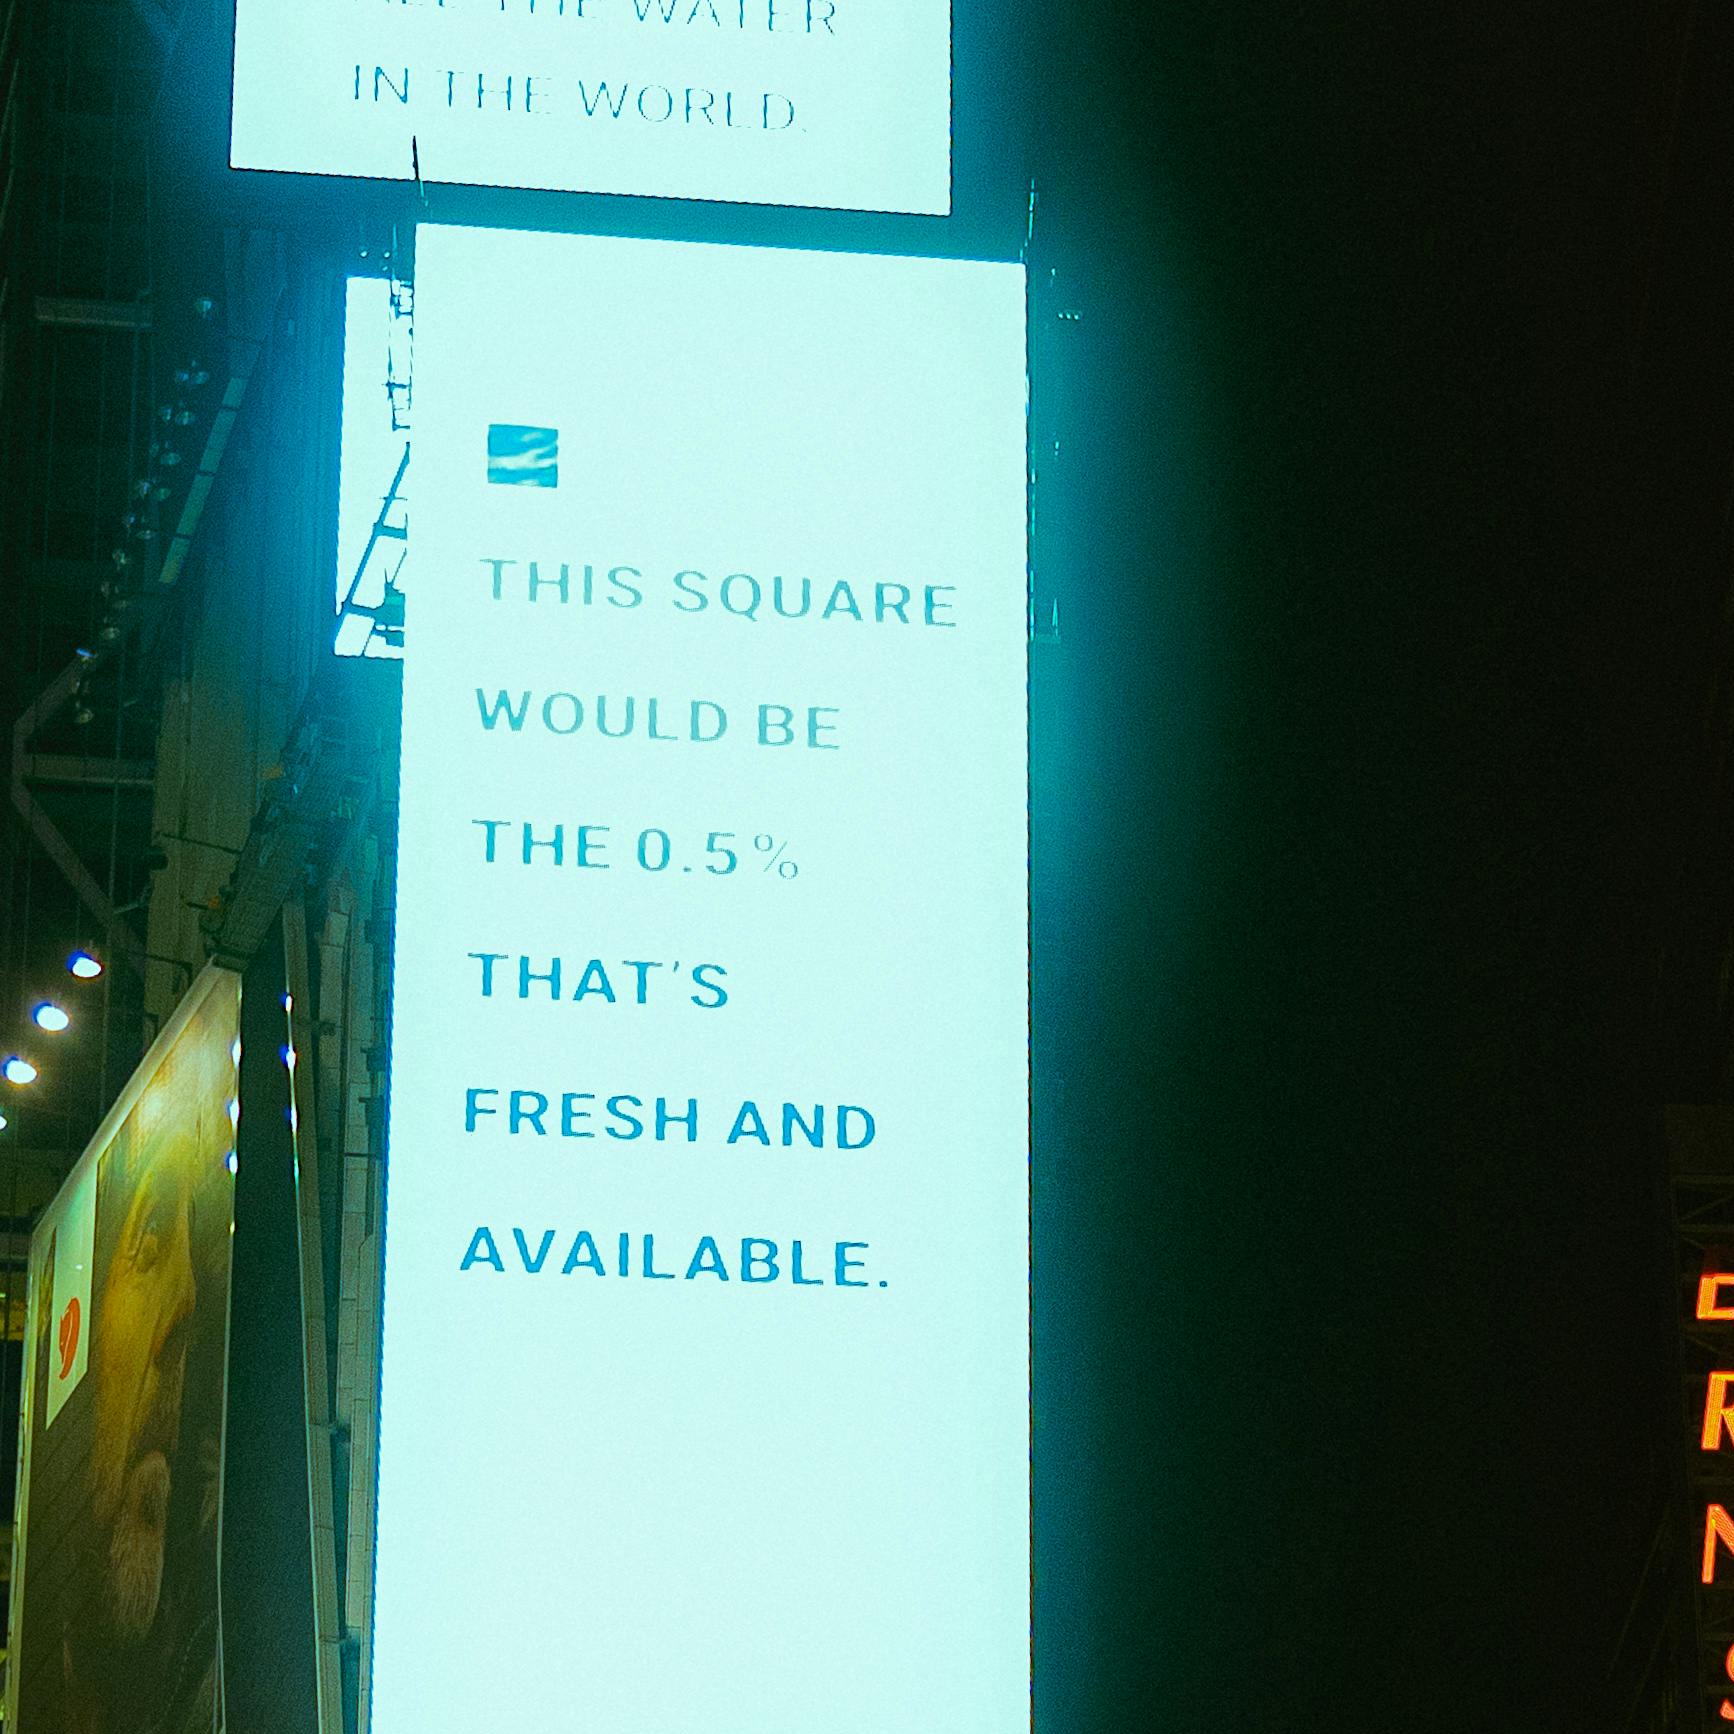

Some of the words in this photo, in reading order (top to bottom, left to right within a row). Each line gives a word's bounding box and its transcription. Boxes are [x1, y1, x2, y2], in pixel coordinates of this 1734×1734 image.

[353, 64, 410, 105] IN
[436, 69, 553, 115] THE
[578, 79, 808, 134] WORLD.
[478, 558, 646, 610] THIS
[672, 570, 959, 629] SQUARE
[474, 686, 729, 744] WOULD
[757, 703, 841, 751] BE
[471, 818, 612, 869] THE
[636, 827, 800, 881] 0.5%
[466, 951, 731, 1010] THAT'S
[463, 1086, 699, 1143] FRESH
[726, 1099, 877, 1151] AND
[459, 1225, 890, 1289] AVAILABLE.
